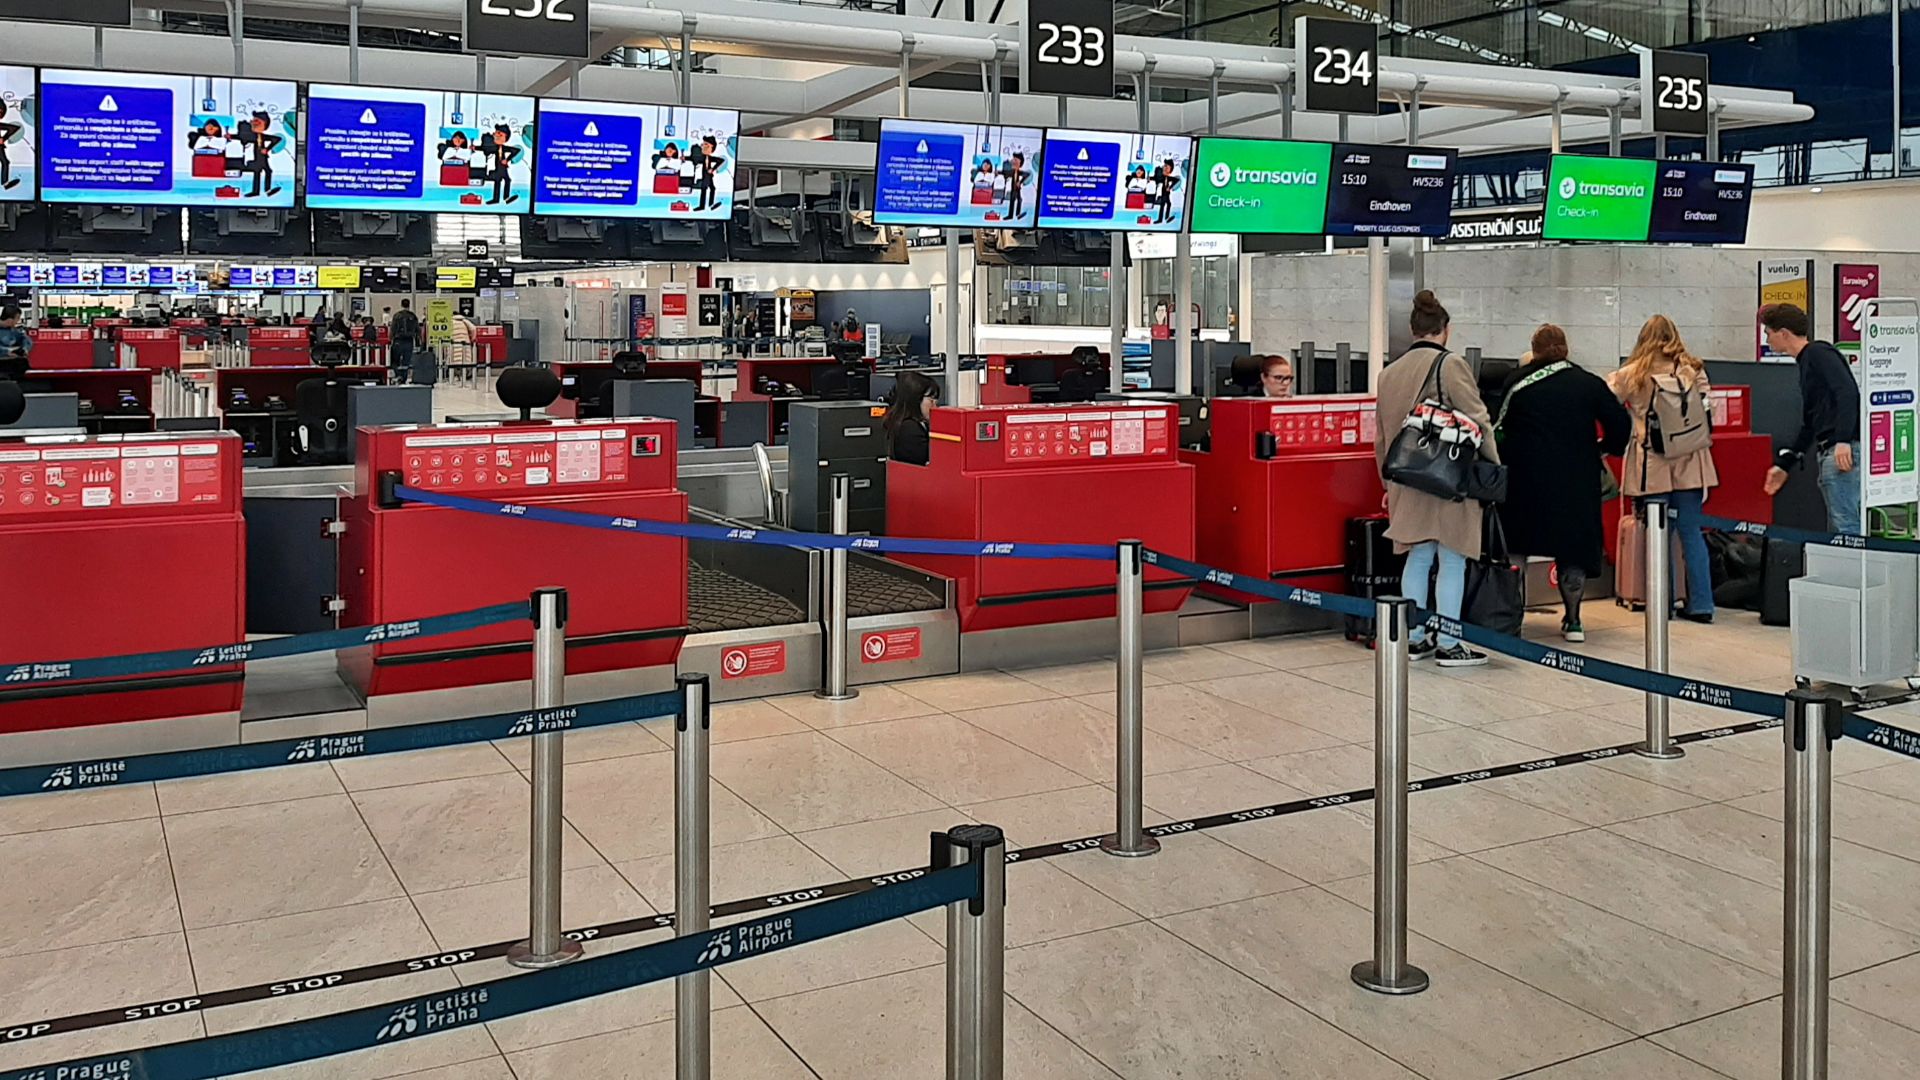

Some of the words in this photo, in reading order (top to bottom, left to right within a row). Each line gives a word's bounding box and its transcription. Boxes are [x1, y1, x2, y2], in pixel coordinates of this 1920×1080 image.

[1038, 23, 1104, 67] 233
[1313, 47, 1373, 86] 234
[1658, 76, 1703, 111] 235
[1235, 167, 1317, 185] transavia
[1341, 174, 1367, 185] 15:10
[1579, 180, 1644, 198] transavia
[1208, 194, 1261, 209] Check-in
[1369, 200, 1411, 211] Eindhoven
[1557, 205, 1599, 218] Check-in
[1684, 211, 1717, 221] Eindhoven
[1450, 217, 1514, 238] ASISTENČNÍ
[1767, 263, 1800, 276] vueling
[1843, 276, 1868, 287] Eurowings
[1880, 326, 1915, 335] transavia
[1869, 345, 1886, 353] Check
[1887, 346, 1900, 355] your
[388, 621, 420, 631] Prague
[388, 627, 420, 638] Airport
[219, 643, 252, 654] Letiště
[219, 652, 247, 661] Praha
[33, 663, 71, 672] Prague
[1559, 662, 1581, 673] Praha
[32, 670, 70, 680] Airport
[1700, 684, 1731, 698] Prague
[1700, 693, 1731, 706] Airport
[538, 709, 577, 721] Letiště
[538, 719, 571, 730] Praha
[320, 735, 364, 747] Prague
[1893, 730, 1920, 747] Prag
[320, 744, 364, 757] Airport
[1893, 739, 1920, 754] Airpo
[1582, 748, 1618, 760] STOP
[78, 761, 127, 775] Letiště
[1520, 760, 1556, 771] STOP
[78, 772, 118, 784] Praha
[1453, 771, 1491, 783] STOP
[1309, 794, 1351, 807] STOP
[1231, 807, 1275, 821] STOP
[1150, 821, 1195, 836] STOP
[1062, 837, 1101, 851] STO
[871, 869, 925, 887] STOP
[767, 888, 824, 907] STOP
[738, 916, 792, 939] Prague
[738, 930, 793, 953] Airport
[406, 951, 476, 971] STOP
[270, 974, 343, 995] STOP
[426, 989, 489, 1012] Letiště
[125, 999, 202, 1020] STOP
[426, 1007, 479, 1029] Praha
[57, 1058, 131, 1080] Prague
